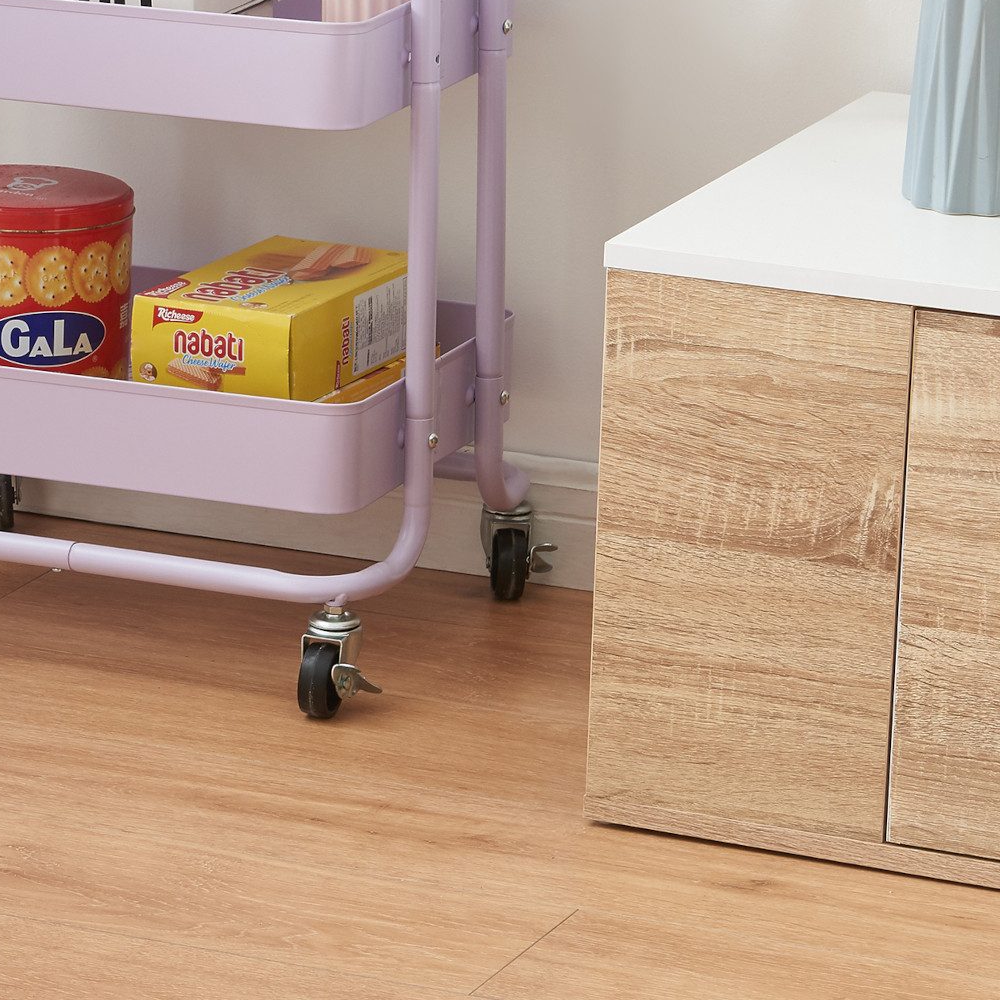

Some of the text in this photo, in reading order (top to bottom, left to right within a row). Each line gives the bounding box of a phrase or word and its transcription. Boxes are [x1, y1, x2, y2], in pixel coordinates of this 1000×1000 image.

[157, 307, 195, 323] Richeese
[173, 328, 244, 362] nabati
[341, 315, 350, 366] nabati
[182, 354, 236, 370] Cheese Wafer
